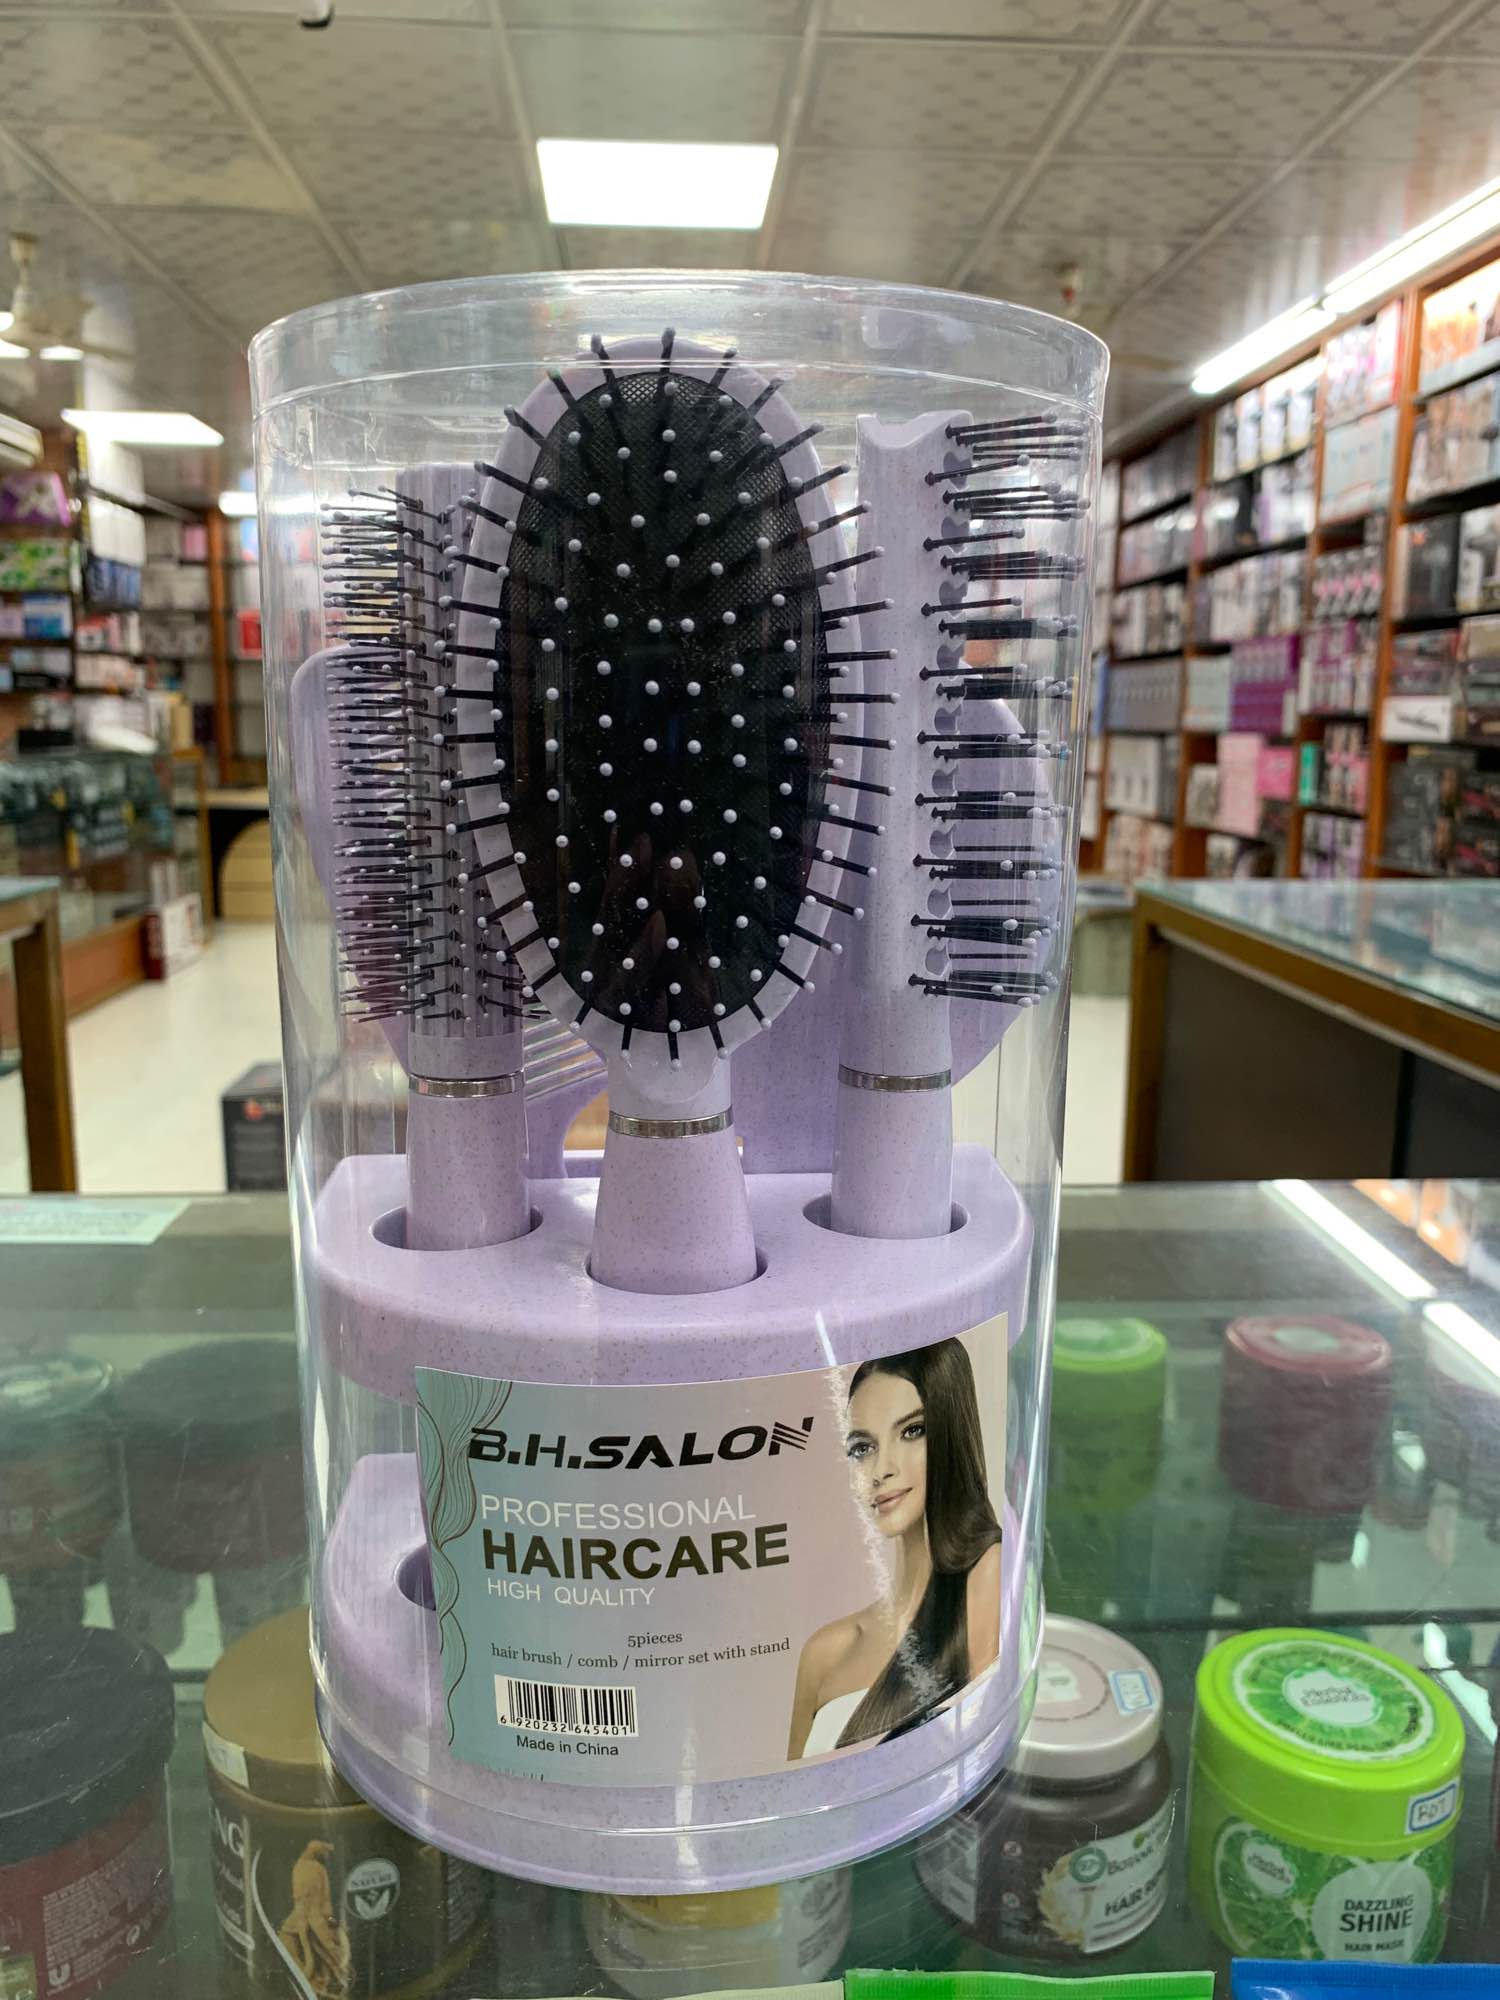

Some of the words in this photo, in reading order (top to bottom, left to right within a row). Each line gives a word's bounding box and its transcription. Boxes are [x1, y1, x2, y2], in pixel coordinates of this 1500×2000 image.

[467, 1416, 814, 1469] B.H.SALON
[480, 1494, 757, 1530] PROFESSIONAL
[482, 1523, 790, 1580] HAIRCARE
[486, 1577, 541, 1602] HIGH
[554, 1586, 656, 1606] QUALITY
[491, 1642, 518, 1660] hair
[522, 1648, 562, 1666] brush
[577, 1654, 618, 1668] comb
[634, 1654, 684, 1668] mirror
[688, 1651, 709, 1664] set
[713, 1645, 746, 1661] with
[750, 1637, 791, 1656] stand
[626, 1631, 683, 1648] 5pieces
[516, 1735, 555, 1751] Made
[559, 1741, 571, 1753] in
[576, 1742, 619, 1756] China
[1344, 1894, 1414, 1912] DAZZLING
[1340, 1907, 1414, 1933] SHINE
